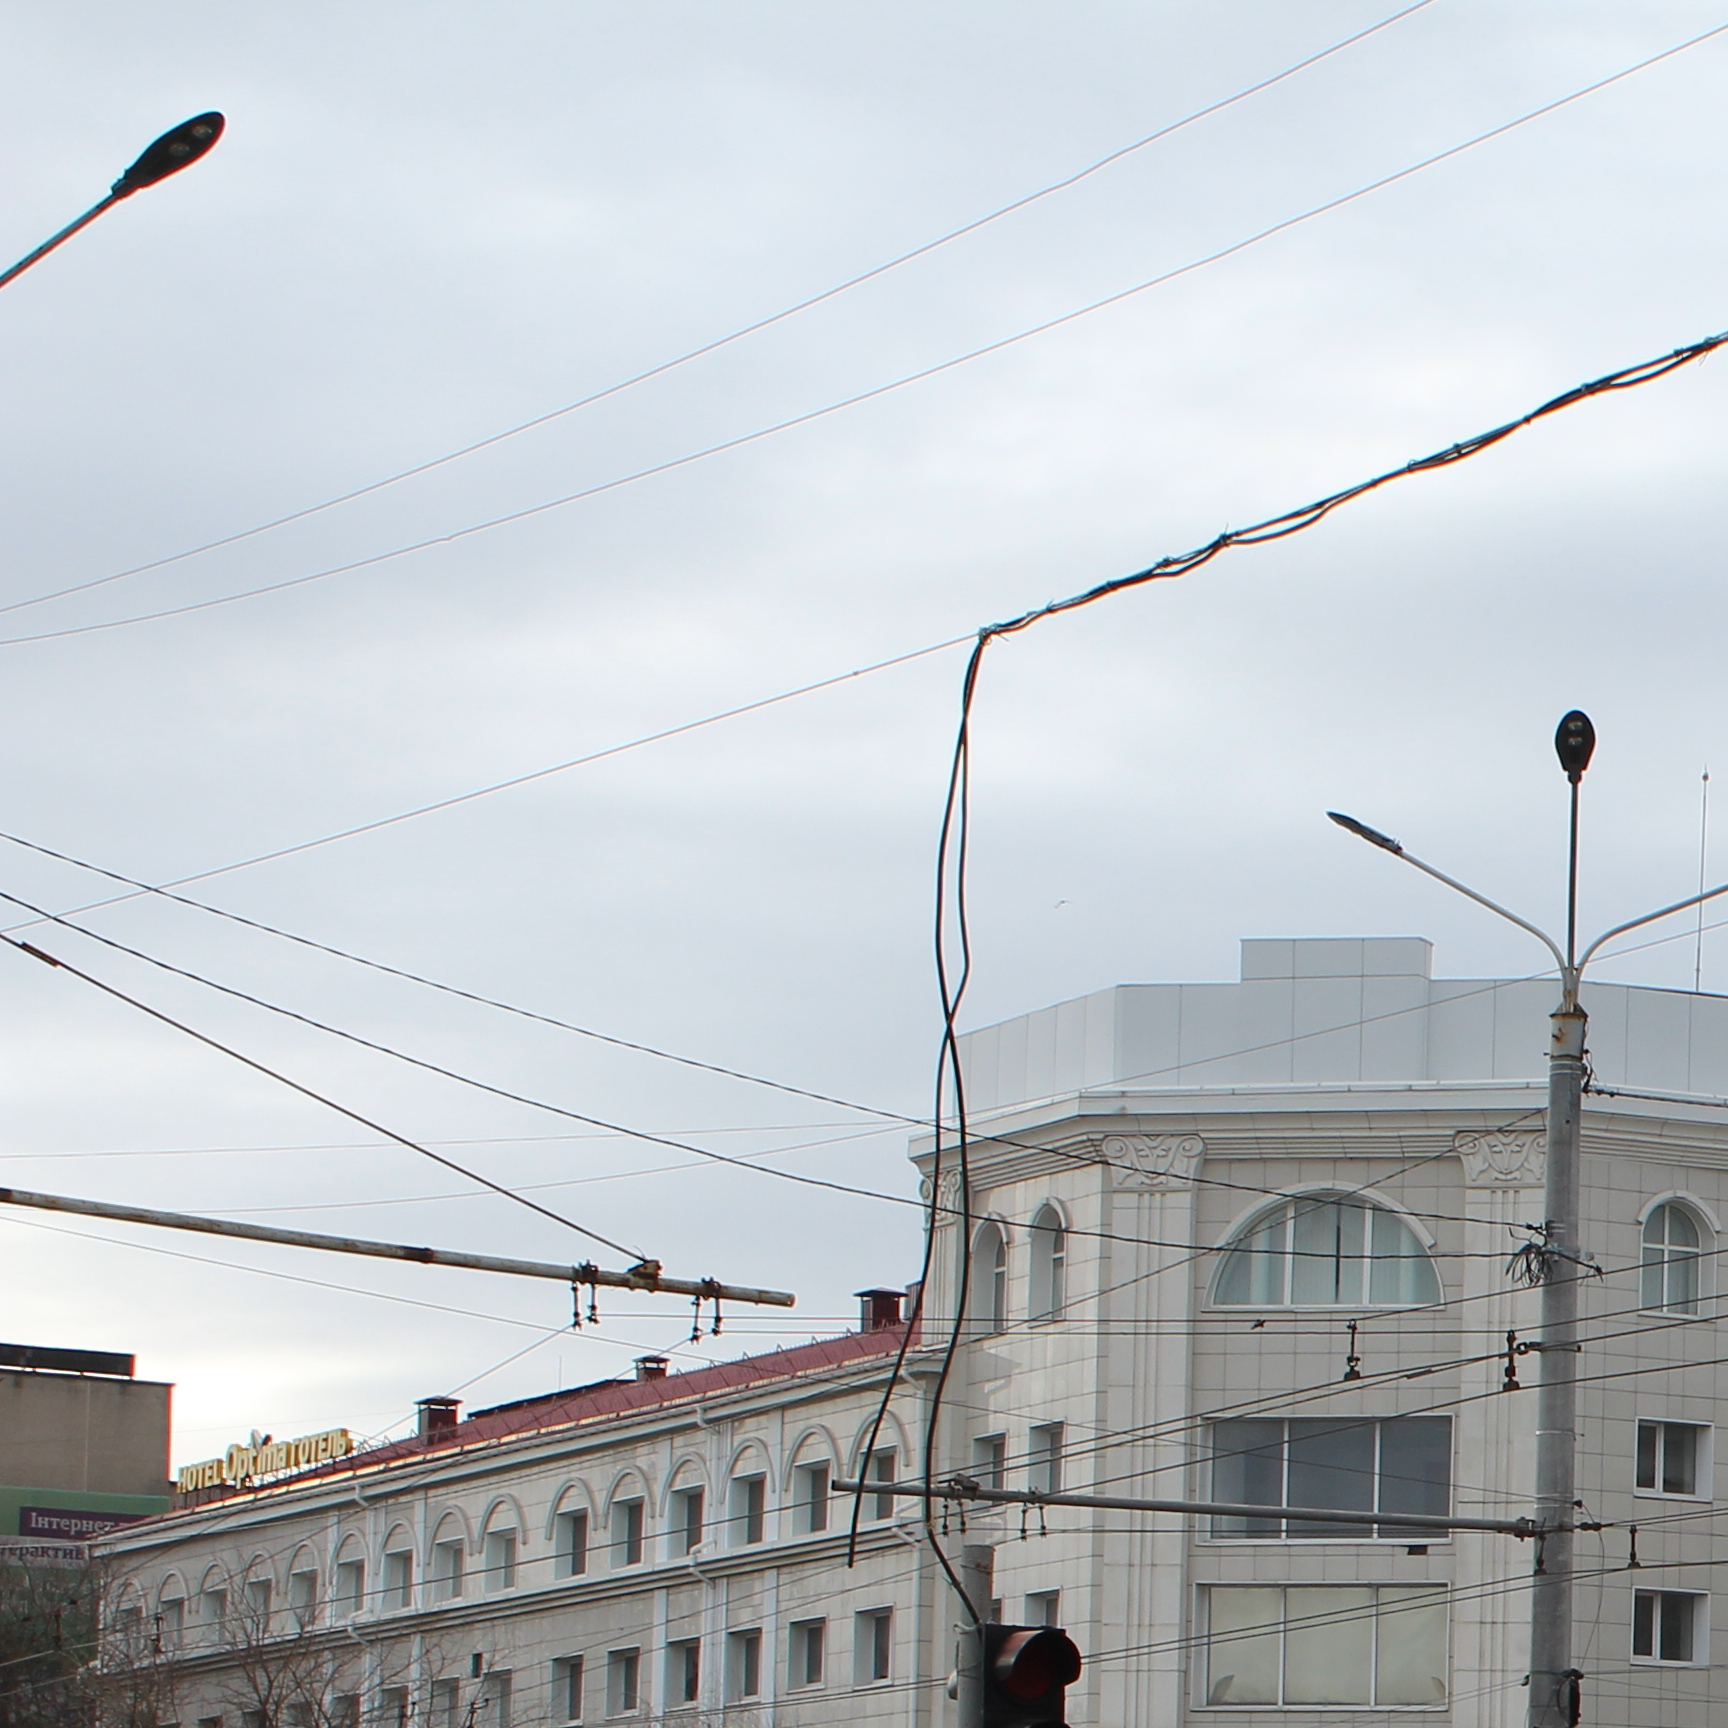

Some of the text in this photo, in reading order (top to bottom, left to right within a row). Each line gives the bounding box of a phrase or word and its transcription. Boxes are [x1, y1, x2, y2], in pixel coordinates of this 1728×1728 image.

[177, 1436, 291, 1493] HOTEL Optima
[292, 1428, 349, 1467] ГОТЕЛЬ
[30, 1512, 115, 1535] Інтернет
